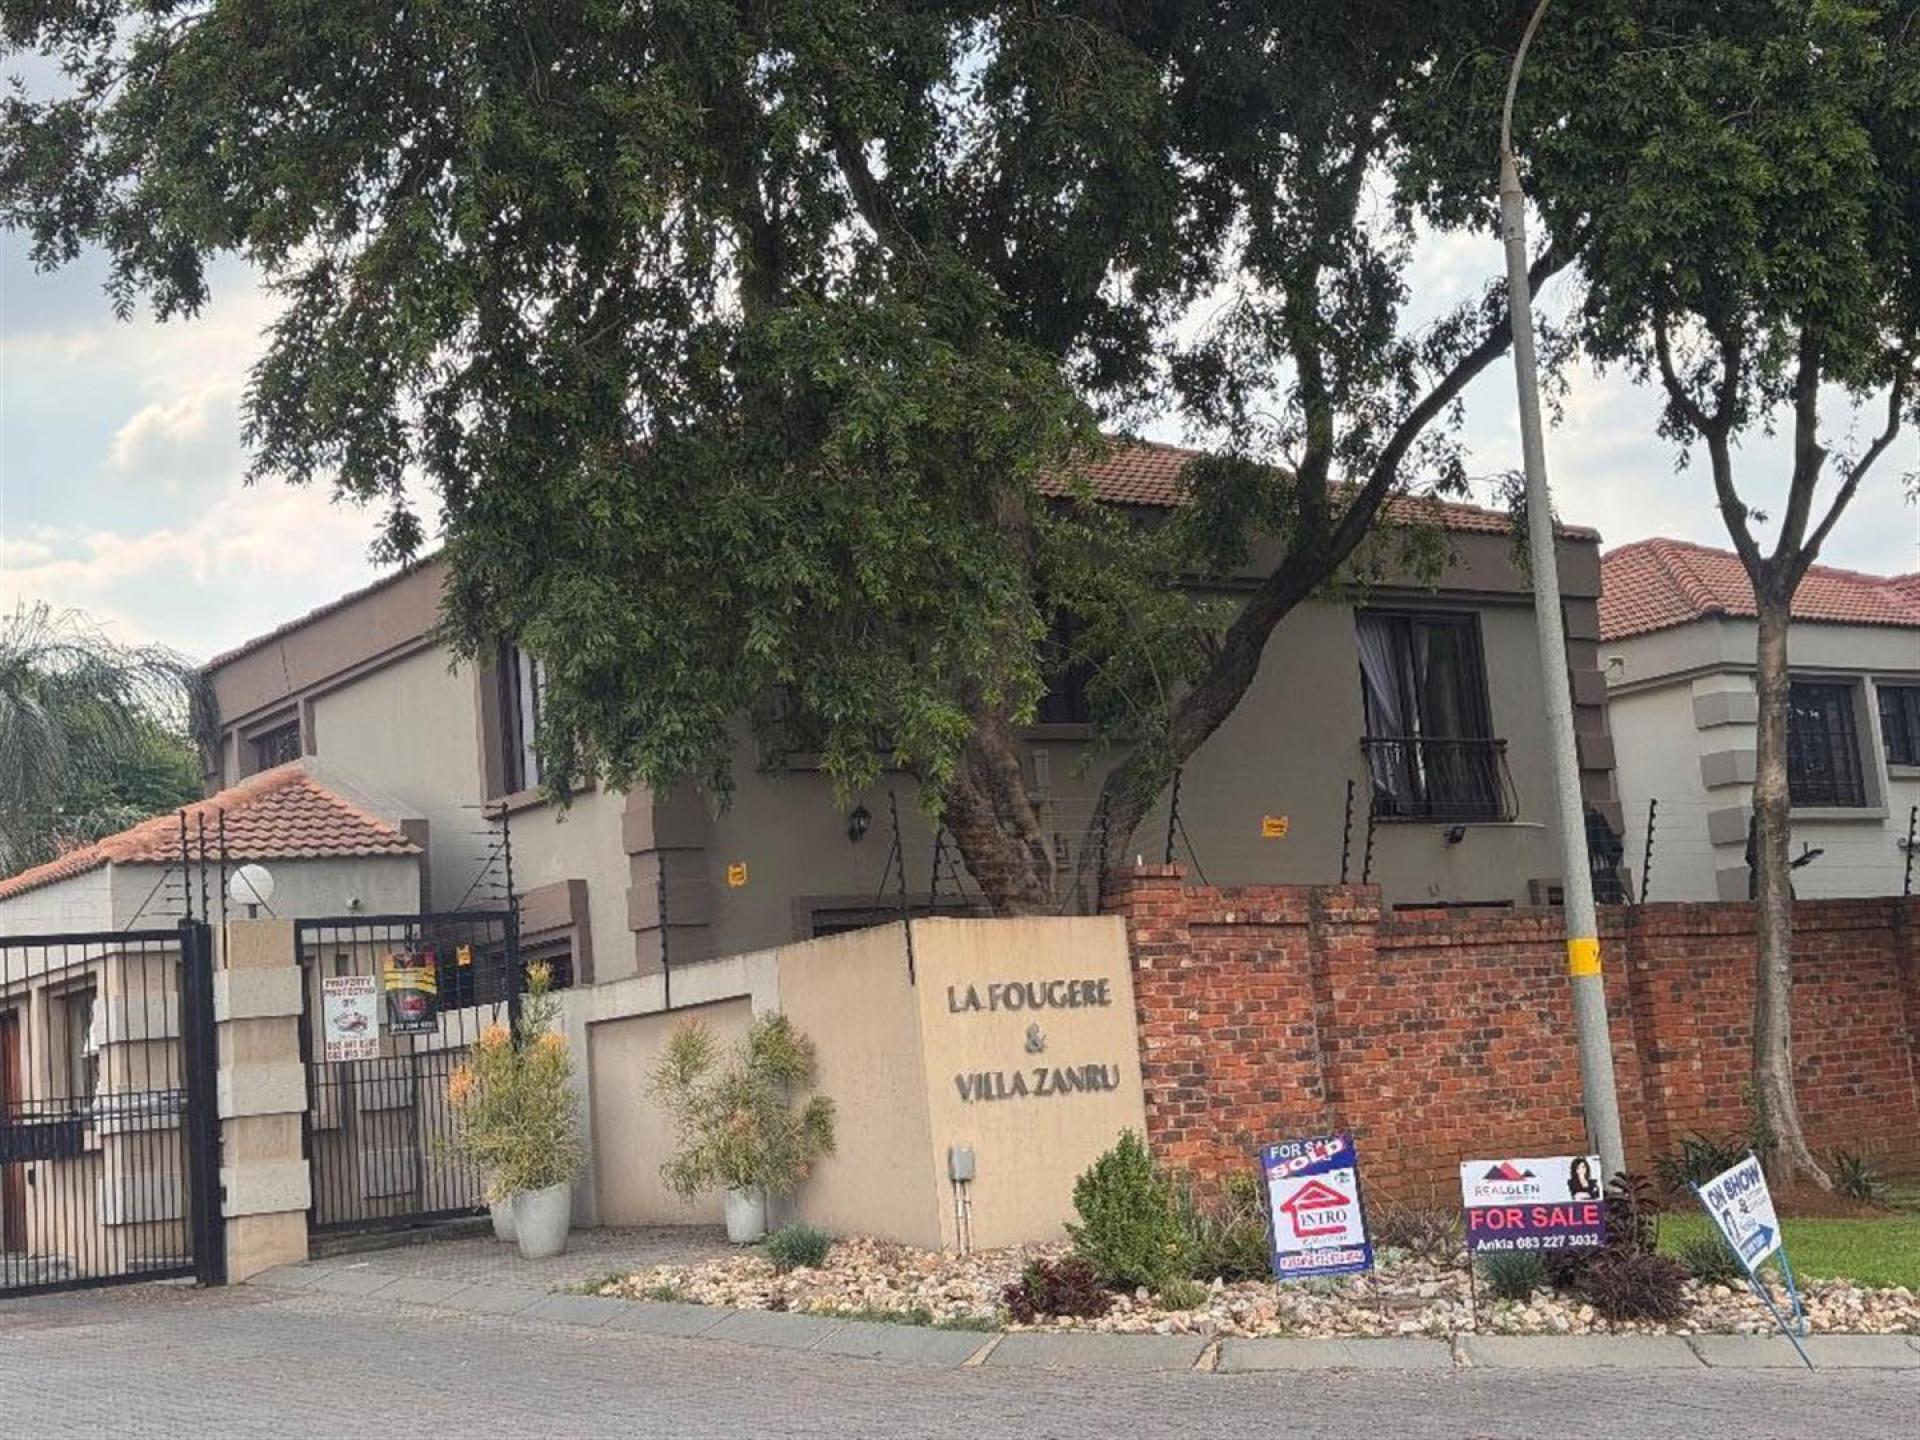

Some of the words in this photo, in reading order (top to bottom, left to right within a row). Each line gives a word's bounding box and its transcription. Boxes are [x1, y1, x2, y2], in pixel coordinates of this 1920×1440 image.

[947, 984, 980, 1013] LA
[987, 978, 1112, 1012] FOUGERE
[1024, 1021, 1048, 1054] &
[955, 1069, 1029, 1102] VILLA
[1031, 1063, 1120, 1097] ZANRU
[1269, 1138, 1344, 1181] SOLD
[1270, 1143, 1302, 1160] FOR
[1707, 1184, 1728, 1213] ON
[1723, 1162, 1760, 1200] SHOW
[1300, 1209, 1348, 1227] INTRO
[1470, 1207, 1525, 1231] FOR
[1531, 1204, 1600, 1227] SALE
[1516, 1236, 1541, 1250] 083
[1543, 1234, 1566, 1248] 227
[1568, 1232, 1599, 1246] 3032
